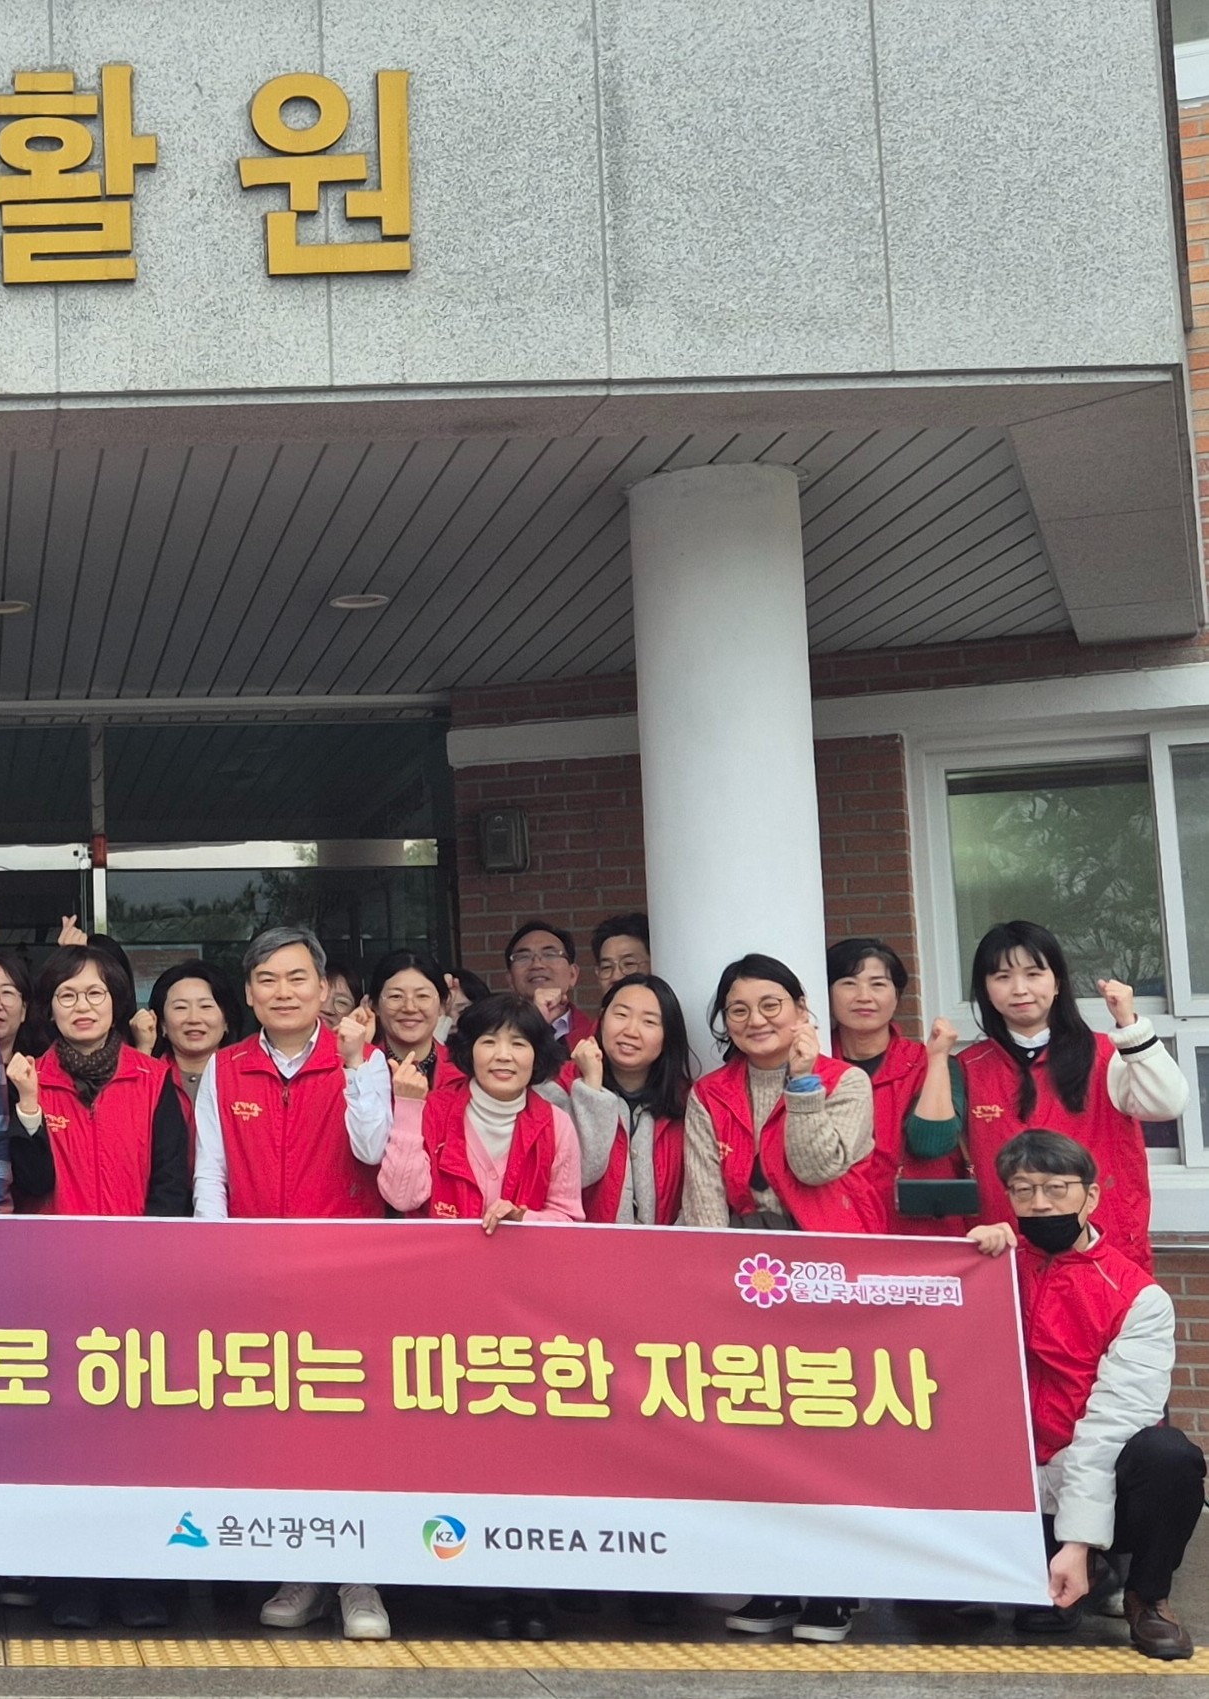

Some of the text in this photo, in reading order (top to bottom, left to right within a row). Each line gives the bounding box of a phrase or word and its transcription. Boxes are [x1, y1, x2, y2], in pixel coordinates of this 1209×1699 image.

[793, 1264, 843, 1281] 2028
[793, 1282, 961, 1303] 울산국제정원박람회
[76, 1327, 366, 1411] 하나되는
[392, 1334, 615, 1418] 따뜻한
[635, 1342, 938, 1430] 자원봉사
[216, 1515, 365, 1549] 울산광역시
[435, 1531, 454, 1543] KZ
[484, 1527, 668, 1554] KOREA ZINC
